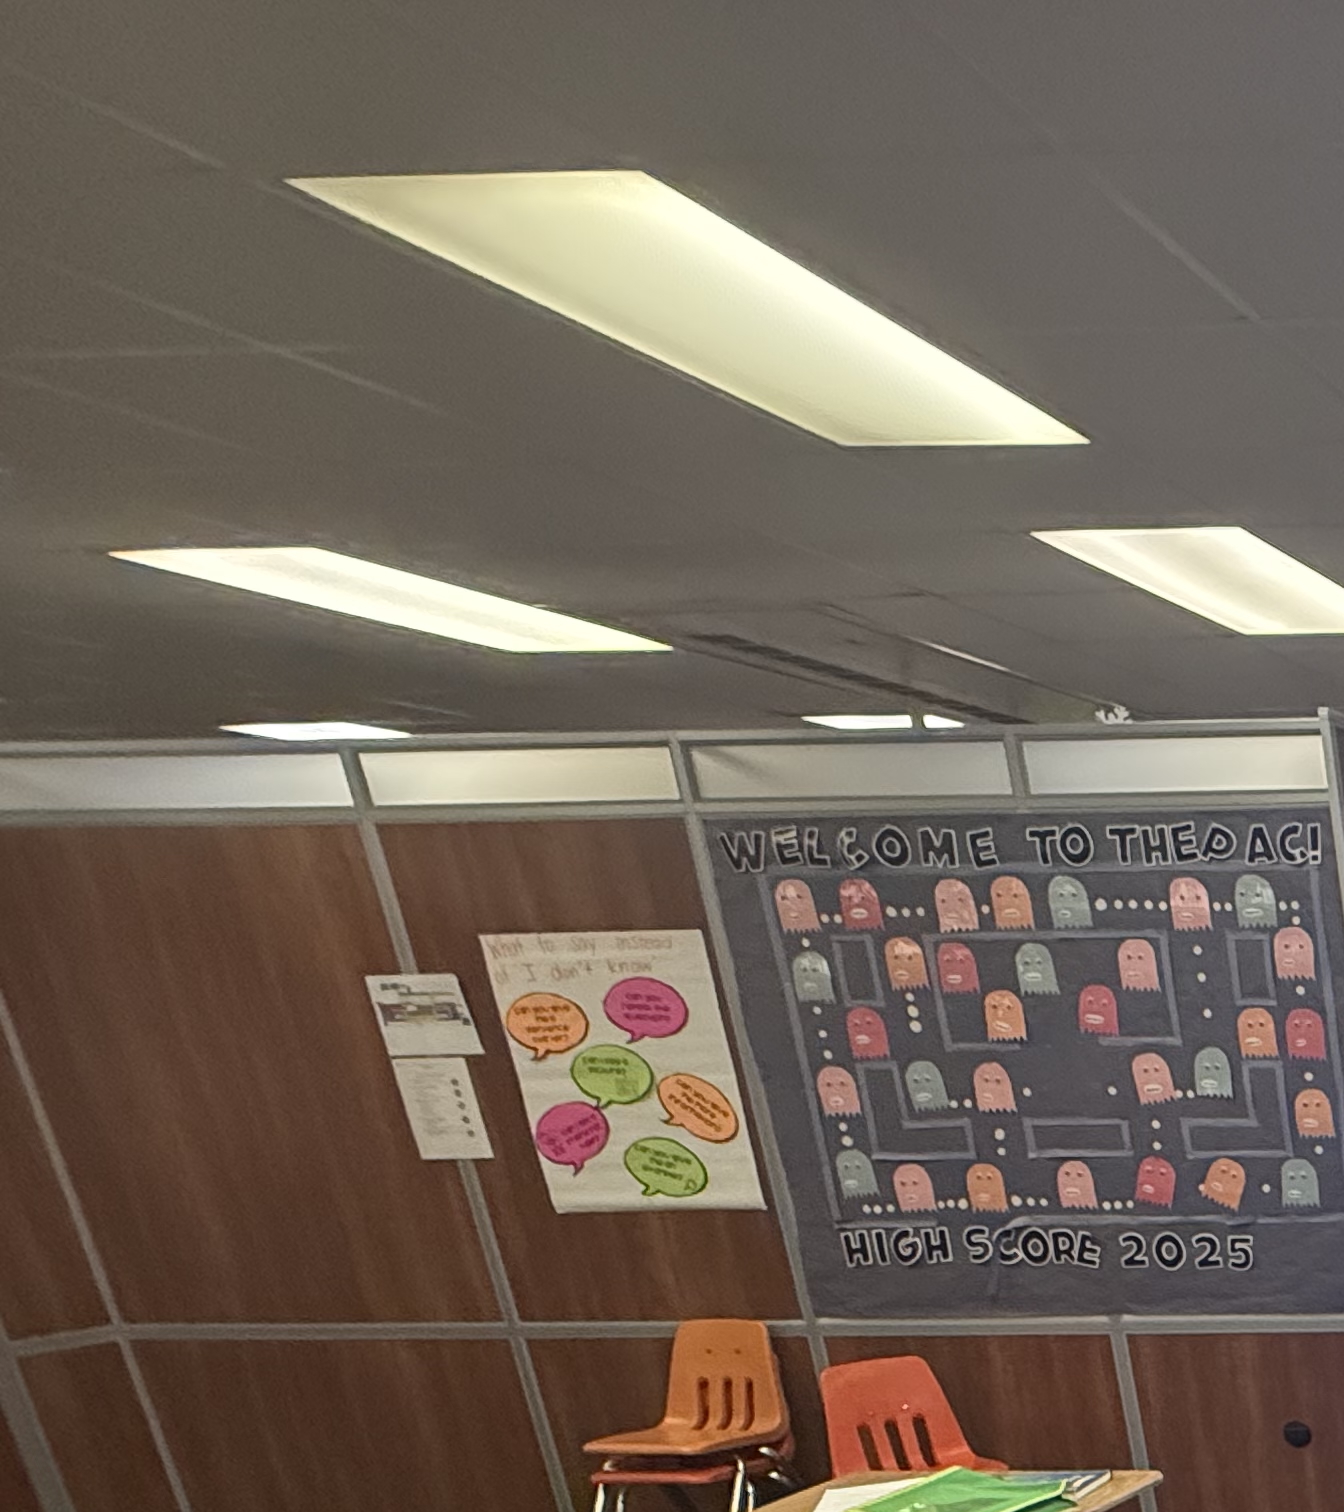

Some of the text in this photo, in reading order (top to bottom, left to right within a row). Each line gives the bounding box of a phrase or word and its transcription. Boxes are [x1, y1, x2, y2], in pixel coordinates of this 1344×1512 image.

[717, 823, 1000, 873] WELCOME
[1026, 822, 1095, 867] TO
[840, 1225, 1254, 1271] HIGH SCORE 2025
